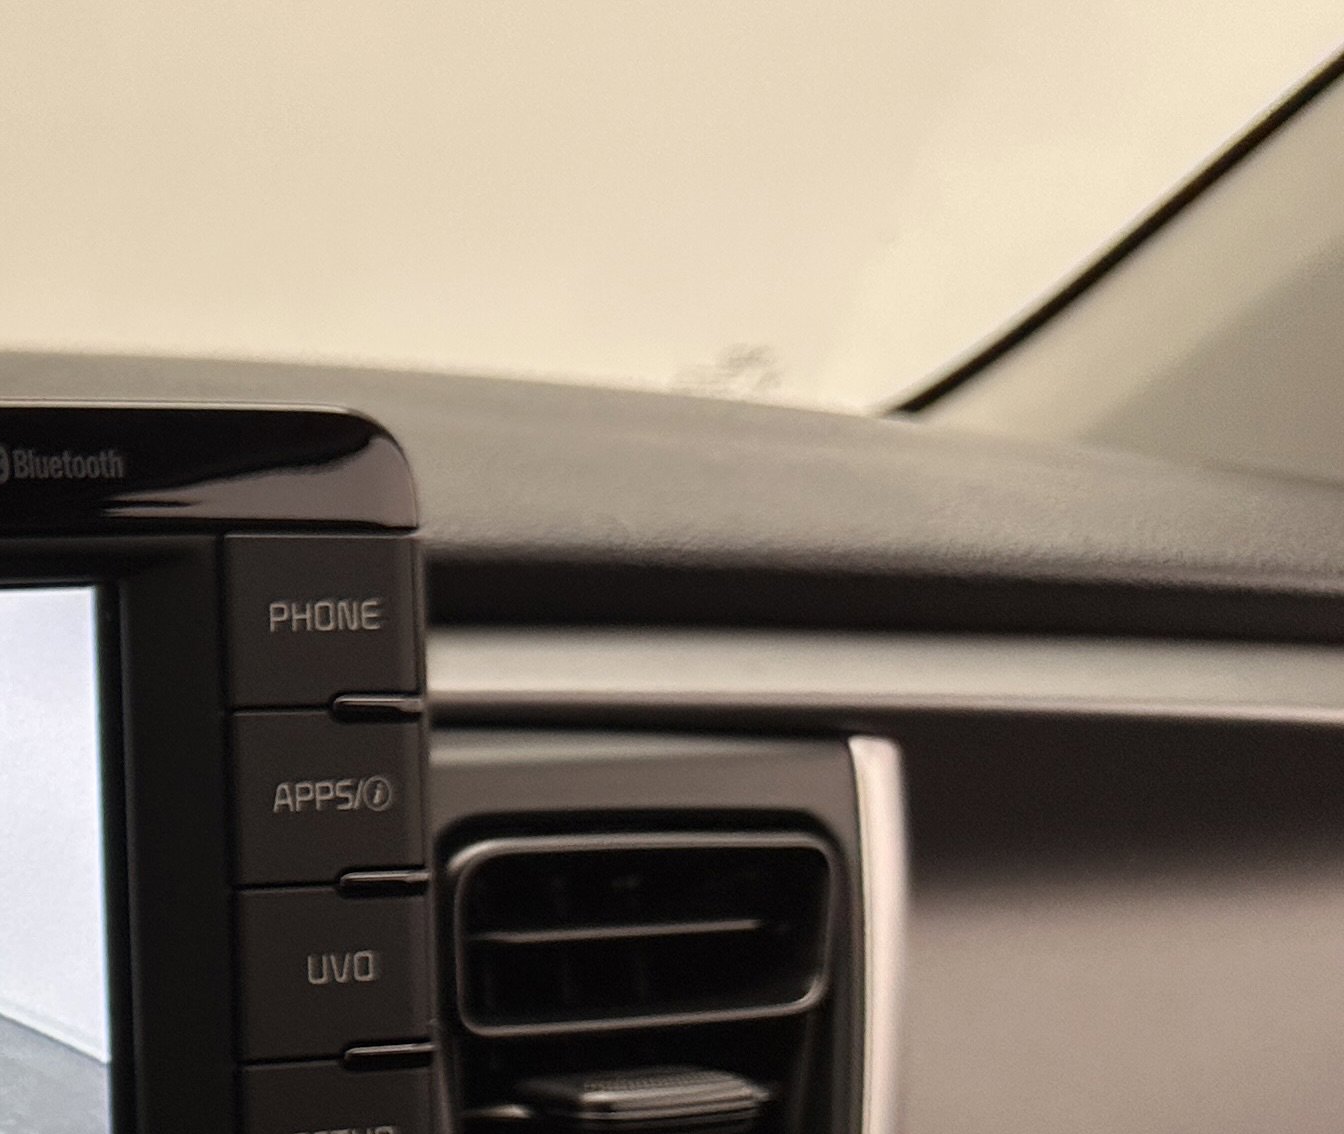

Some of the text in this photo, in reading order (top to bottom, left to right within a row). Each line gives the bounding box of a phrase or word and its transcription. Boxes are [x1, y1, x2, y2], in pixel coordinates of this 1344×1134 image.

[13, 449, 124, 479] Bluetooth
[269, 600, 382, 632] PHONE
[307, 951, 376, 984] UVO
